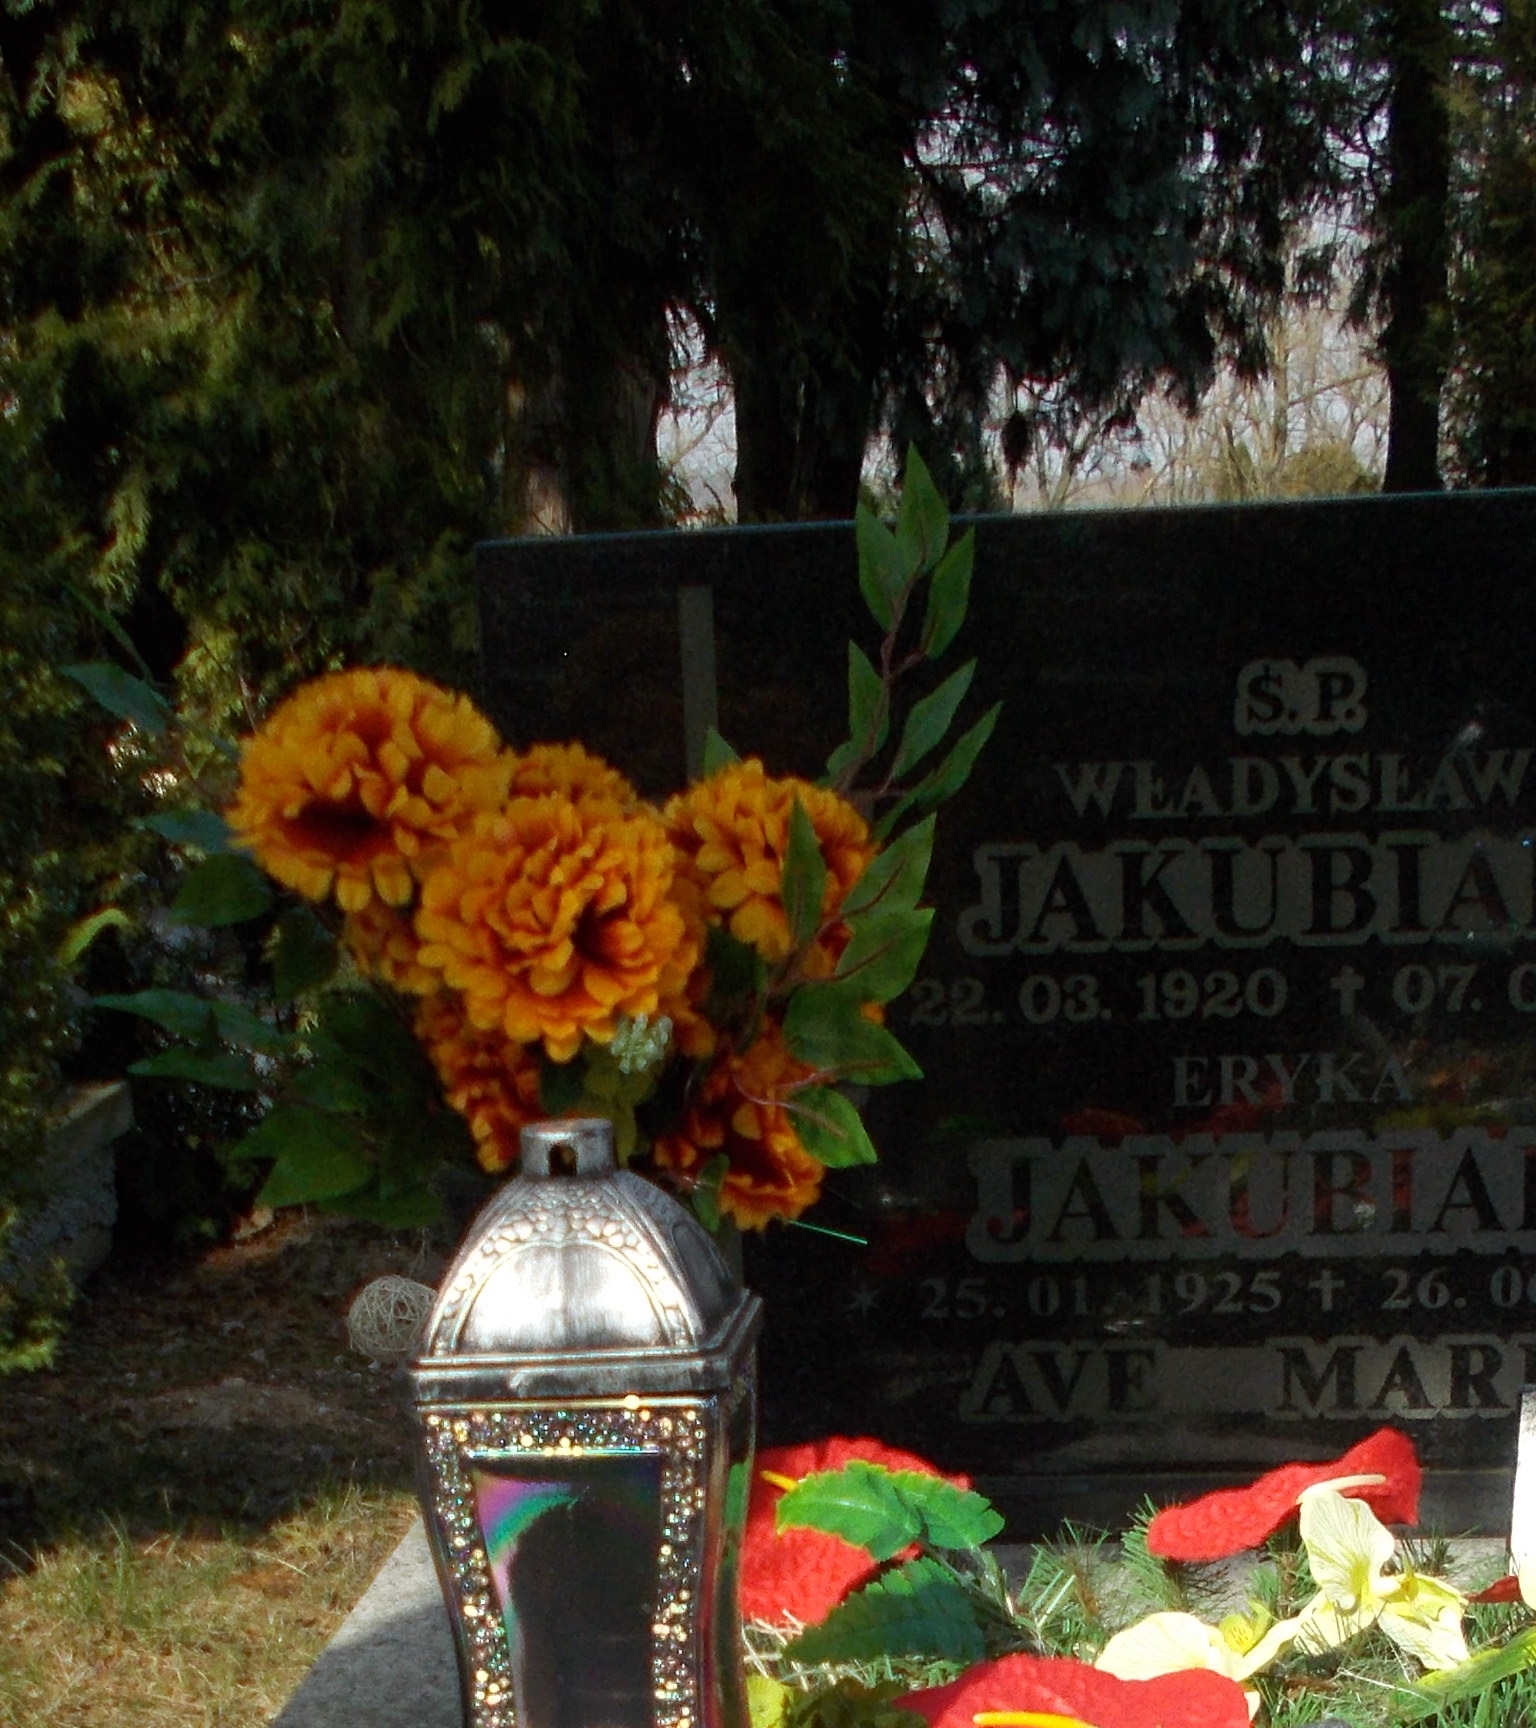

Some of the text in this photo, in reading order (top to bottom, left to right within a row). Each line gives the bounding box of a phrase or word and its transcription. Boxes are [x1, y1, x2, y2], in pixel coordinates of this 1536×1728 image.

[1018, 975, 1111, 1023] 03.
[1137, 968, 1286, 1019] 1920
[1393, 963, 1481, 1010] 07.
[1172, 1053, 1414, 1108] ERYKA
[920, 1277, 1005, 1320] 25.
[1146, 1270, 1285, 1316] 1925
[1381, 1267, 1467, 1311] 26.
[968, 1343, 1162, 1417] AVE
